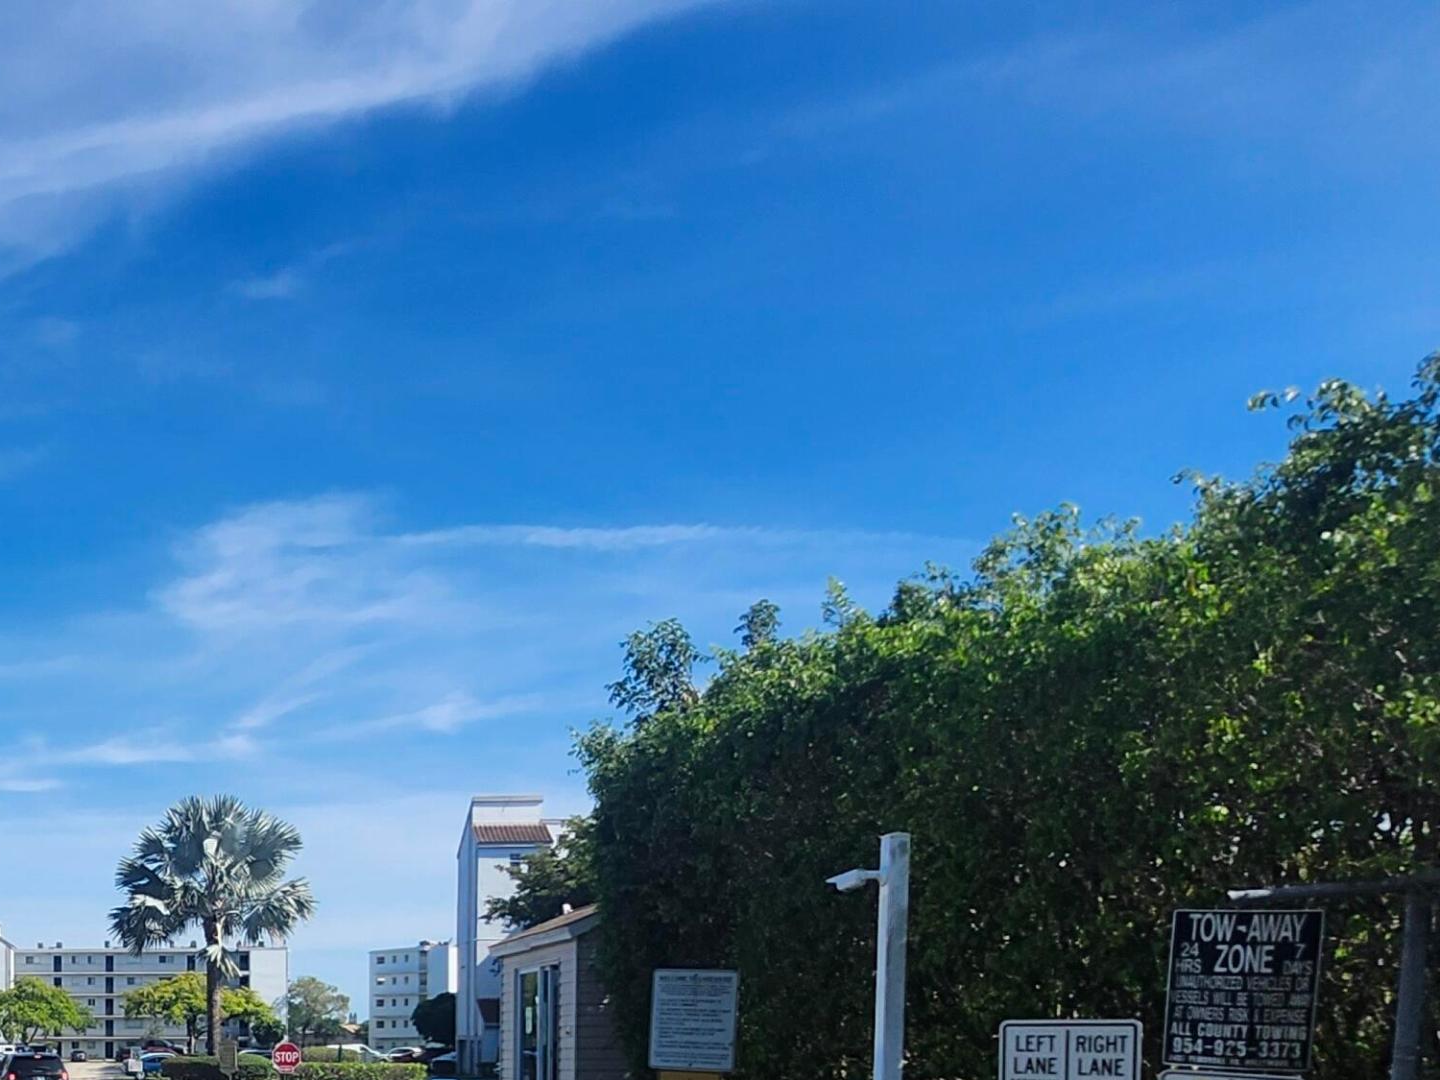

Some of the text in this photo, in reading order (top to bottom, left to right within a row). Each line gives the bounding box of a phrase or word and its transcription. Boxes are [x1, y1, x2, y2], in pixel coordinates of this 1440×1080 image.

[1188, 913, 1308, 942] TOW-AWAY
[1181, 942, 1200, 957] 24
[1294, 943, 1306, 959] 7
[1175, 958, 1202, 973] HRS
[1213, 944, 1275, 973] ZONE
[1283, 960, 1313, 975] DAYS
[1175, 975, 1243, 990] UNAUTHORIZED
[1247, 976, 1291, 991] VEHICLES
[1213, 991, 1234, 1006] WILL
[1228, 1008, 1249, 1022] RISK
[1170, 1022, 1308, 1041] ALL COUNTY TOWING
[1015, 1034, 1056, 1053] LEFT
[1075, 1035, 1128, 1053] RIGHT
[275, 1051, 299, 1063] STOP
[1013, 1057, 1058, 1075] LANE
[1077, 1058, 1125, 1077] LANE
